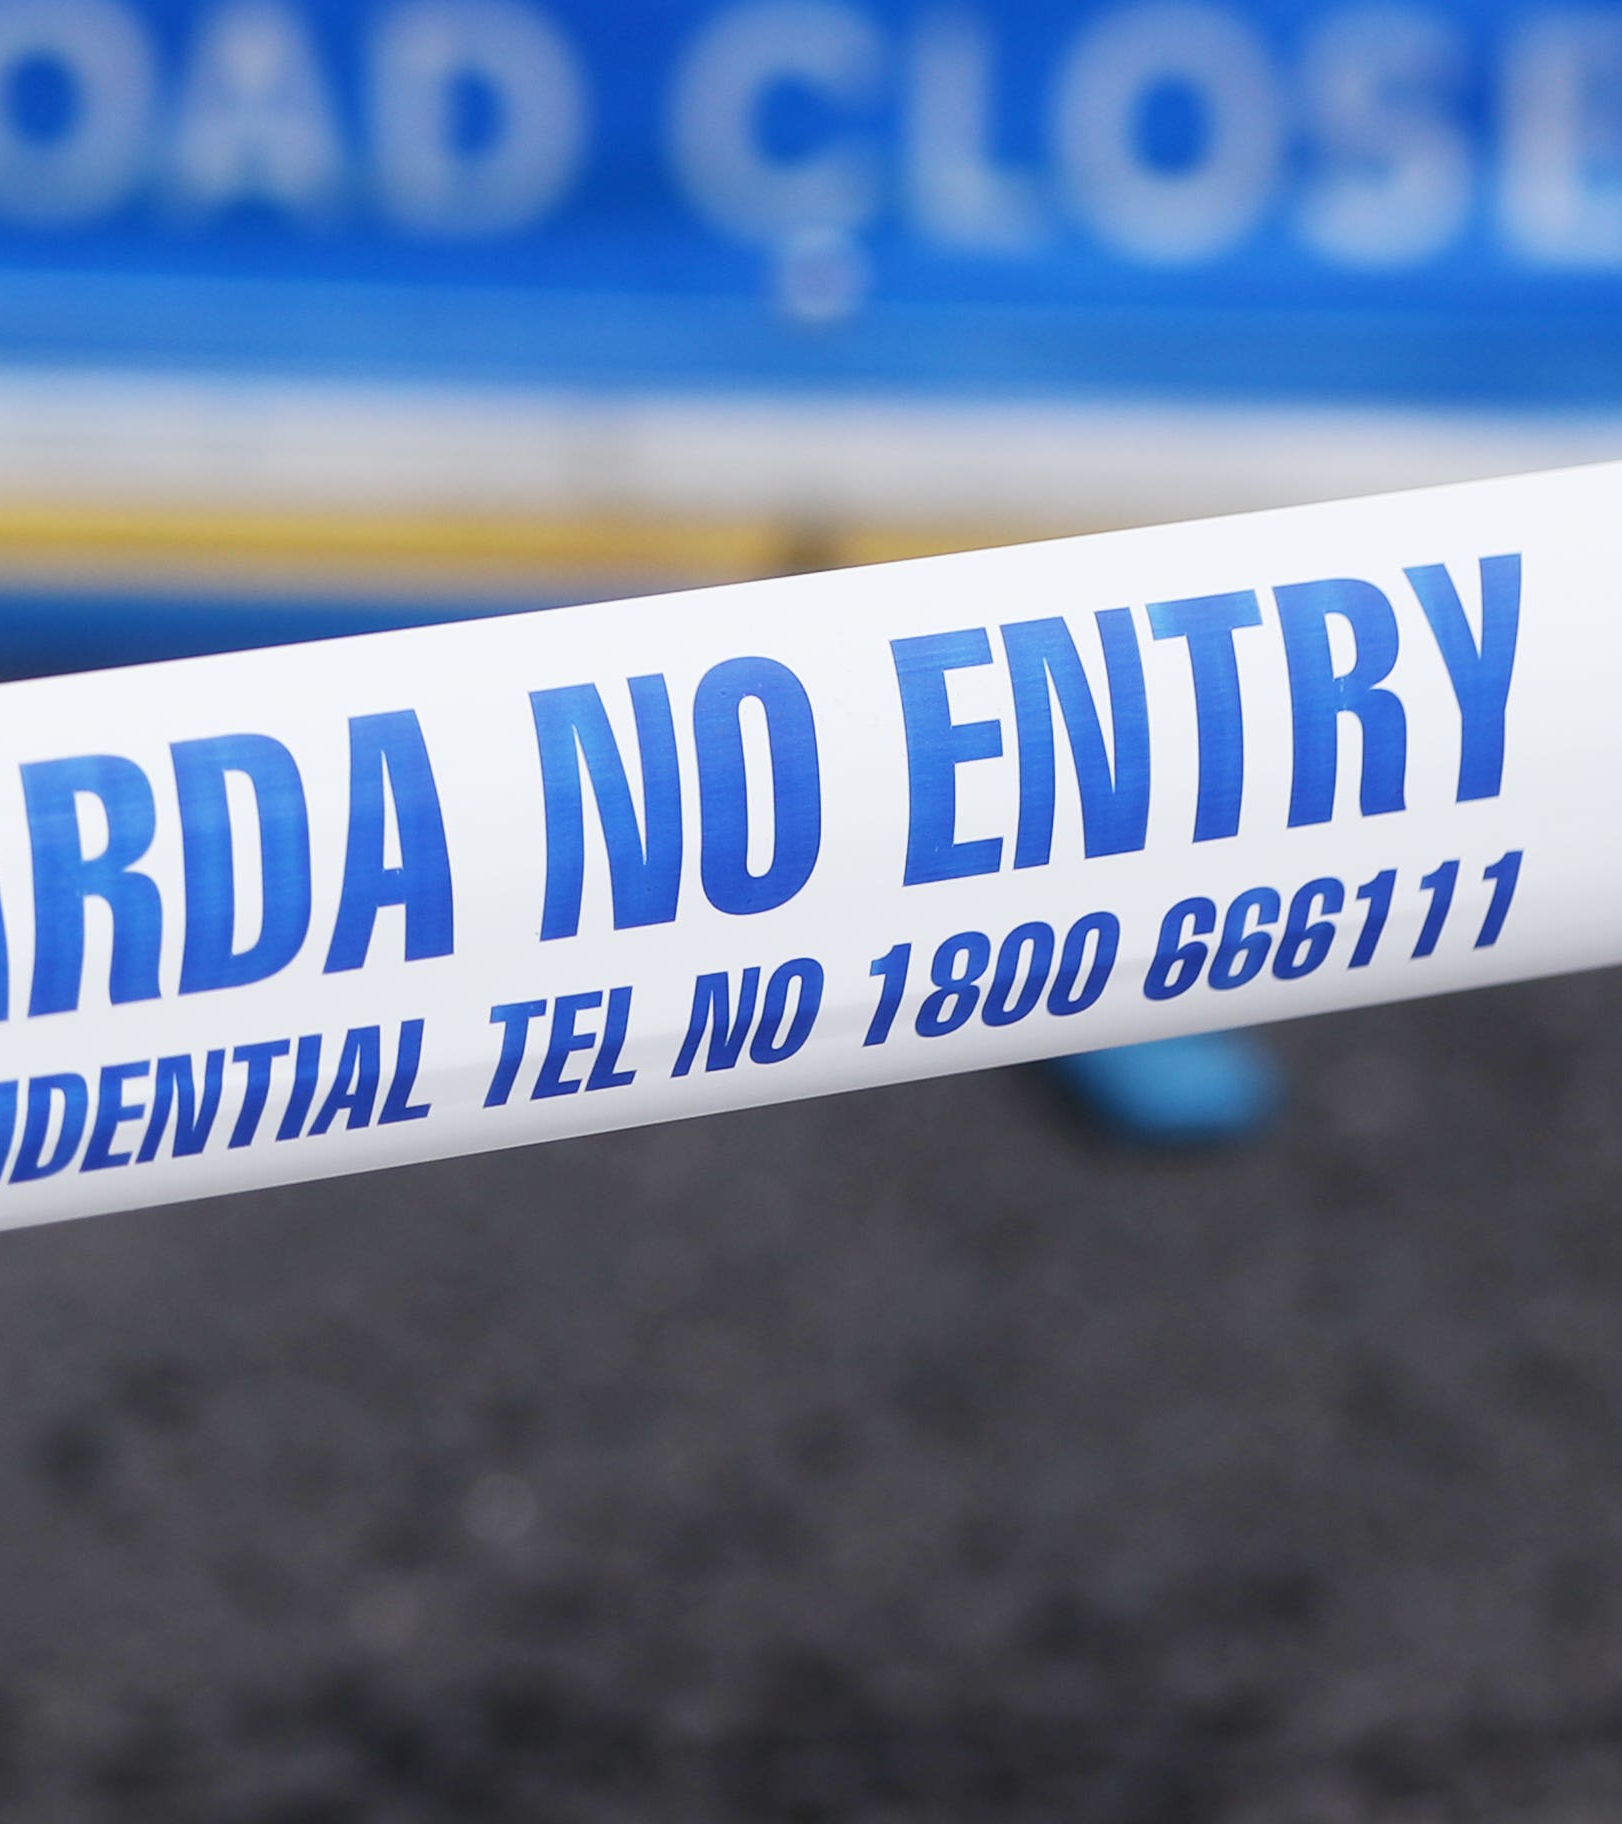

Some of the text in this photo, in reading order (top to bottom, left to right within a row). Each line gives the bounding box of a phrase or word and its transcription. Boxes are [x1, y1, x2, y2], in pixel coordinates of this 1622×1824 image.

[529, 656, 821, 941] NO
[890, 553, 1522, 886] ENTRY
[484, 985, 635, 1108] TEL
[672, 958, 825, 1077] NO
[864, 911, 1121, 1046] 1800
[1144, 850, 1524, 1000] 666111
